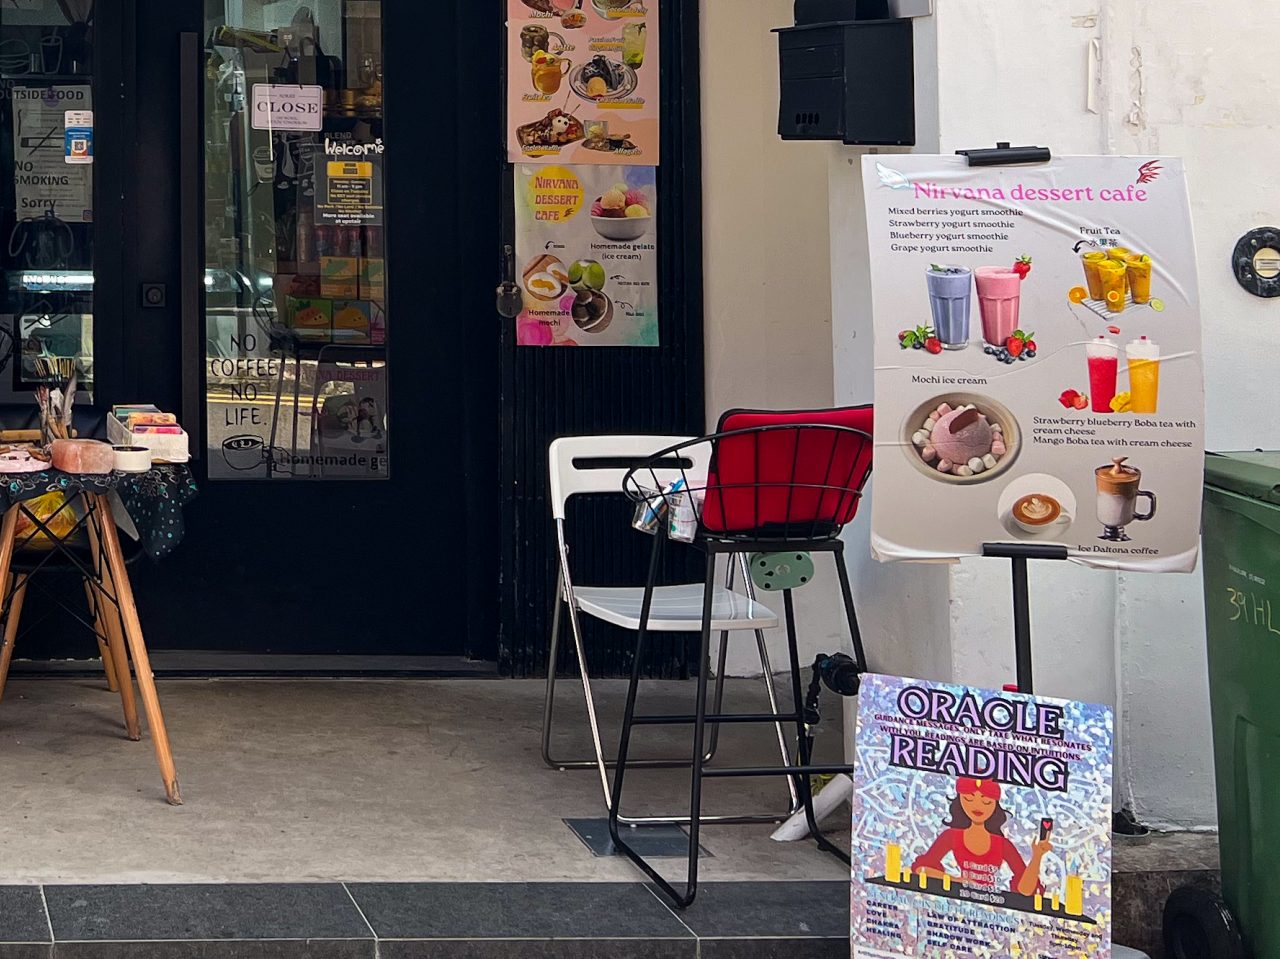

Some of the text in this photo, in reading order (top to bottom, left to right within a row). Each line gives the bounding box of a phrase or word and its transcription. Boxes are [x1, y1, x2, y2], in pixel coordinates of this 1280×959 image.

[257, 101, 318, 114] CLOSE
[324, 138, 384, 155] Welcome
[14, 161, 33, 172] NO
[12, 175, 69, 185] SMOKING
[535, 177, 579, 189] NIRVANA
[913, 182, 1148, 201] Nirvana dessert cafe
[21, 198, 56, 209] Sorry
[535, 195, 579, 205] DESSERT
[535, 210, 559, 220] CAFE
[888, 207, 1024, 218] Mixed berries yogurt smoothie
[889, 219, 1015, 229] Strawberry yogurt smoothie
[890, 231, 932, 241] Blueberry
[933, 232, 965, 241] yogurt
[1080, 226, 1121, 235] Fruit Tea
[632, 243, 655, 251] gelato
[891, 244, 994, 254] Grape yogurt smoothie
[230, 333, 257, 352] NO
[211, 358, 279, 377] COFFEE
[911, 374, 988, 385] Mochi ice cream
[231, 383, 257, 401] NO
[225, 407, 267, 427] LIFE.
[1033, 416, 1196, 428] Strawberry blueberry Boba tea with
[1064, 428, 1096, 436] cheese
[1033, 436, 1065, 445] Mango
[1066, 437, 1090, 445] Boba
[1091, 438, 1105, 446] tea
[1106, 438, 1128, 446] with
[1160, 440, 1193, 448] cheese
[1077, 545, 1092, 553] Ice
[1130, 546, 1159, 555] coffee
[898, 687, 1063, 738] ORACLE
[874, 713, 1092, 752] GUIDANCE ONLY TAKE WHAT RESONATES
[880, 724, 902, 735] WITH
[924, 732, 966, 745] READINGS
[968, 737, 985, 748] ARE
[986, 740, 1014, 752] BASED
[1016, 744, 1029, 754] ON
[892, 735, 1067, 790] READING
[866, 900, 899, 911] CAREER
[866, 909, 888, 919] LOVE
[866, 918, 900, 930] CHAKRA
[927, 912, 1016, 934] LAW OF ATTRACTION
[927, 921, 976, 936] GRATITUDE
[866, 927, 902, 939] HEALING
[926, 929, 991, 948] SHADOW WORK
[927, 939, 973, 954] SELF CARE
